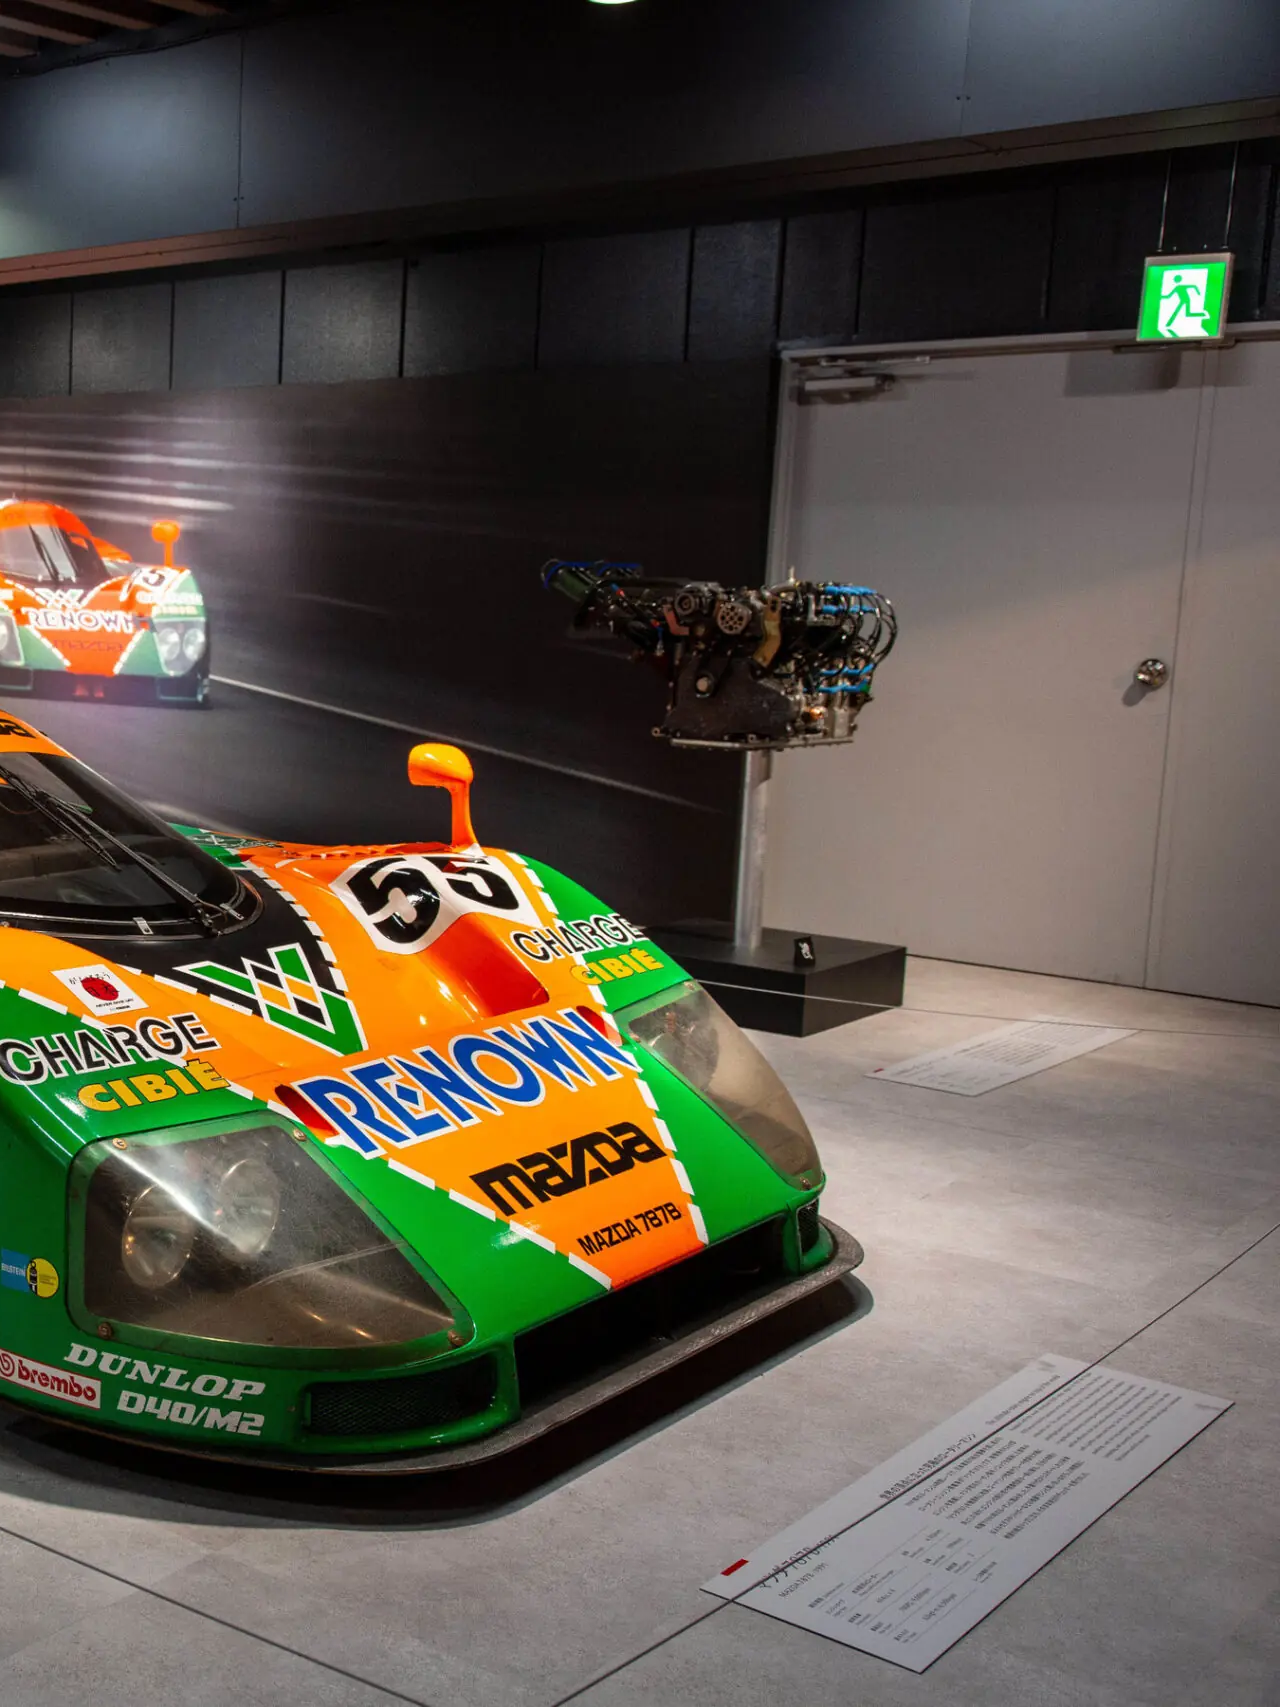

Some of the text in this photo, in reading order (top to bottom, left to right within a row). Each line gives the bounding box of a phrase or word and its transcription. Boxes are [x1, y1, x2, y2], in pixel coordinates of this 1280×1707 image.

[346, 856, 520, 945] 55
[510, 913, 650, 964] CHARGE
[290, 1005, 643, 1160] RENOWN
[469, 1120, 668, 1217] mazda
[576, 1201, 683, 1257] MAZDA 787B
[17, 1359, 97, 1402] brembo
[63, 1342, 266, 1401] DUNLOP
[117, 1390, 265, 1437] D40/M2
